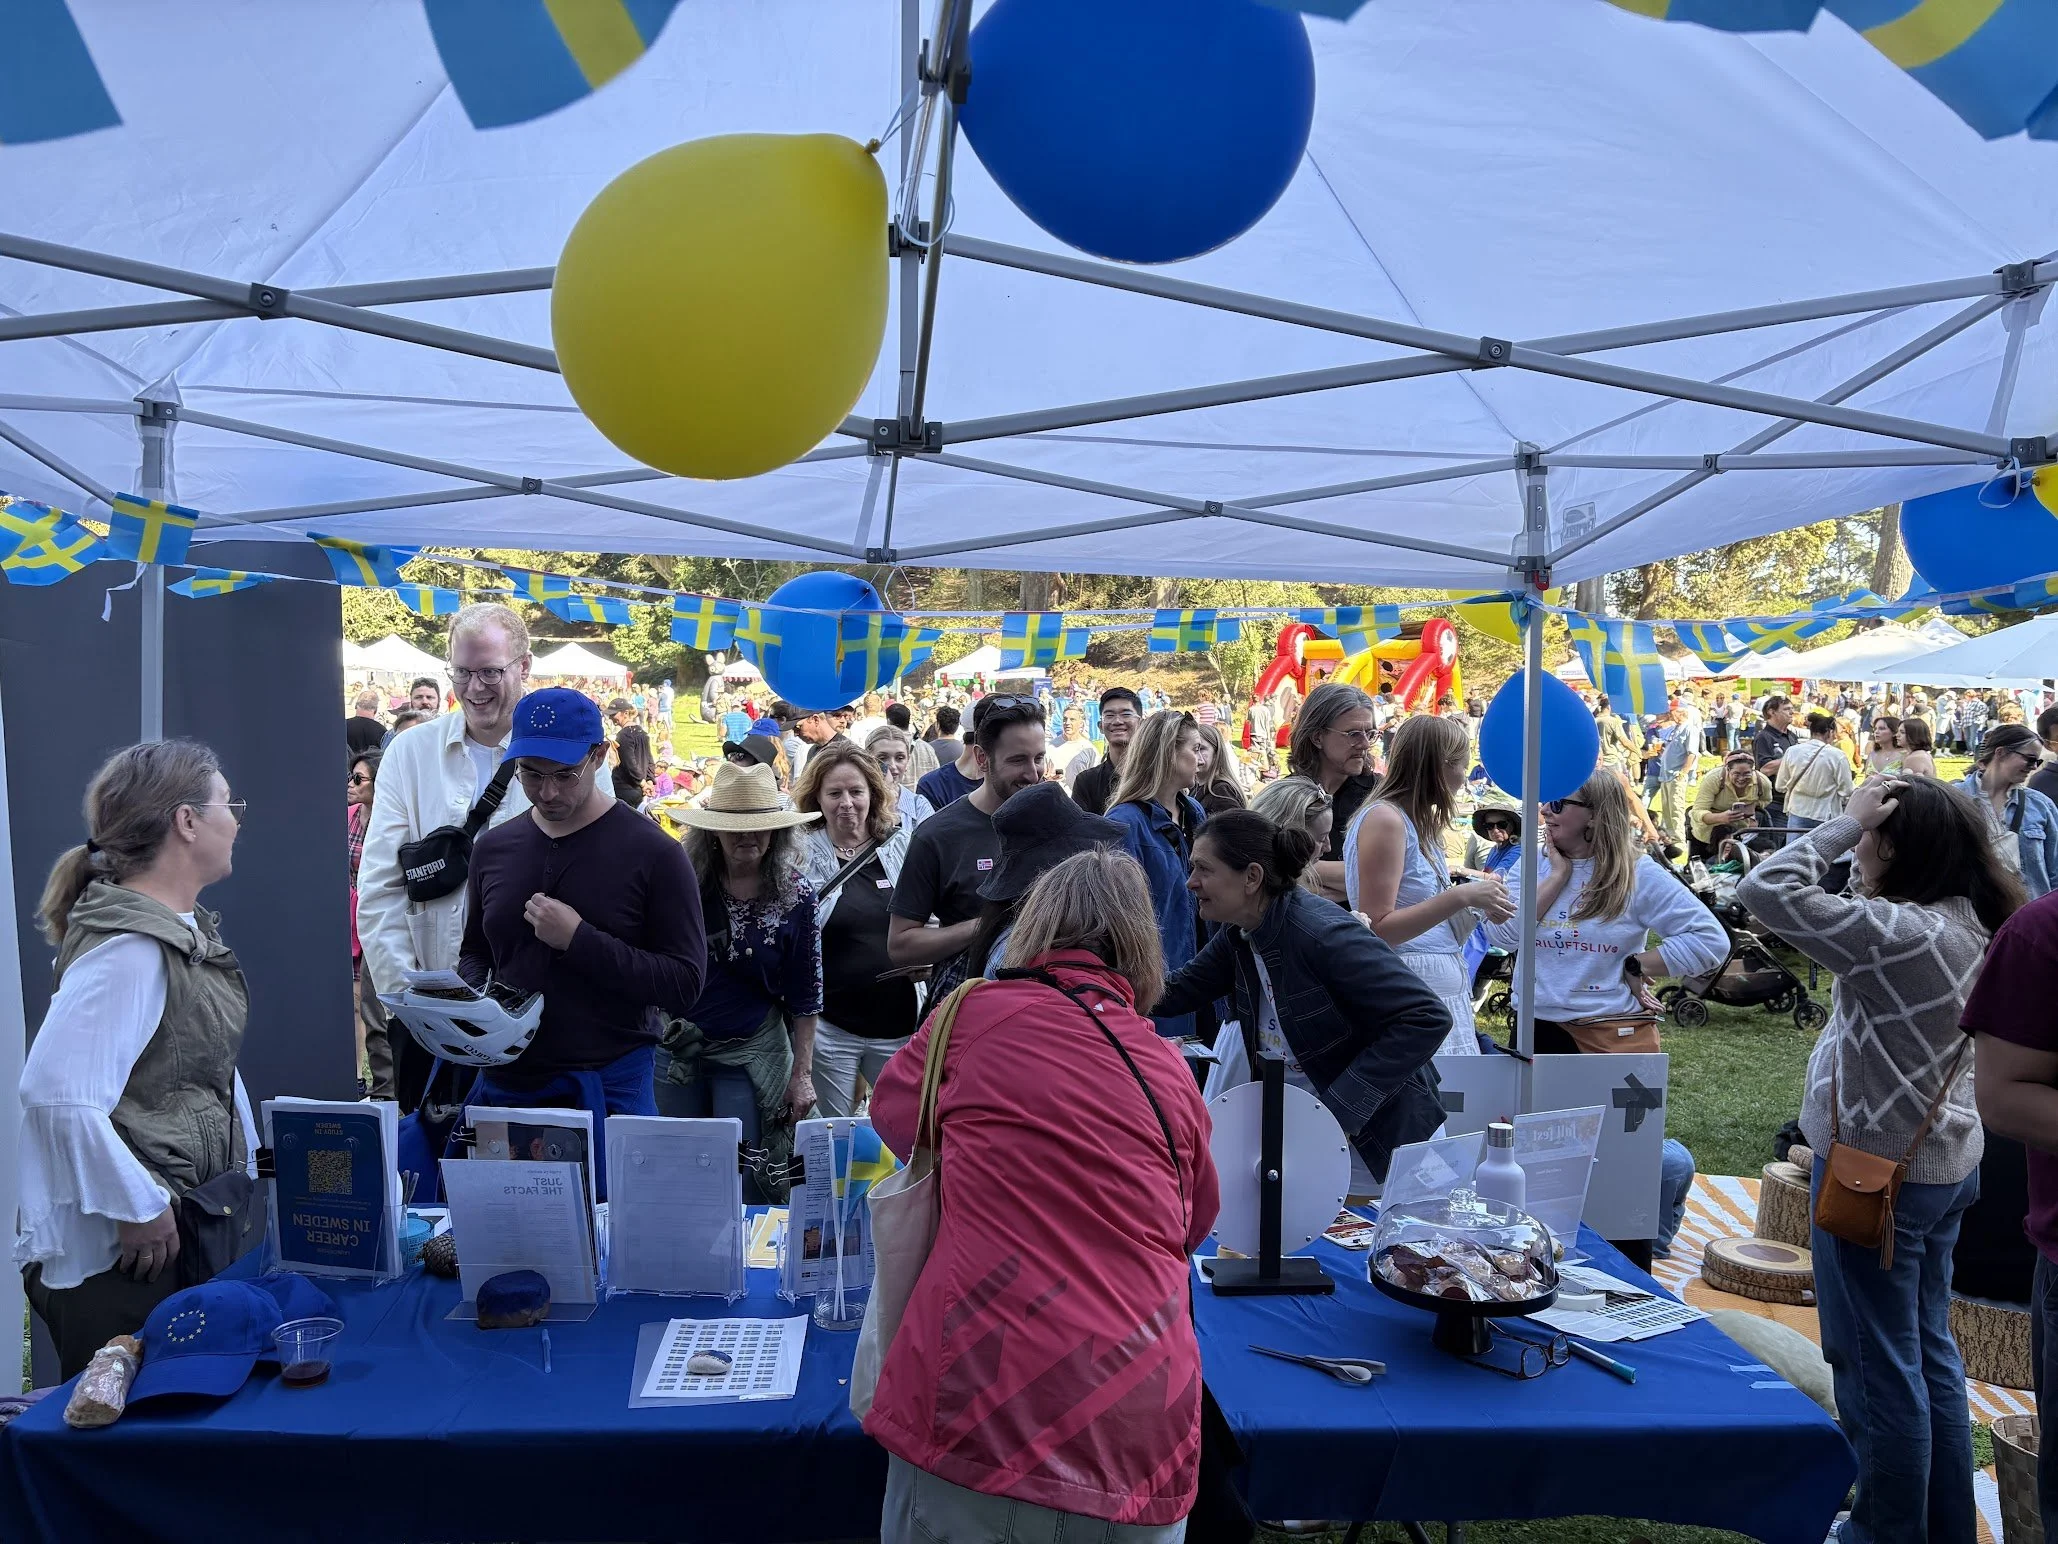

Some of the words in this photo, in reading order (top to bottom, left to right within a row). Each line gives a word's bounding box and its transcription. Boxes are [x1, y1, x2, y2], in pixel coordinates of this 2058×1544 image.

[405, 858, 446, 881] STANFORD
[1535, 939, 1612, 953] RILUFTSLIV
[292, 1213, 350, 1229] SWEDEN
[353, 1219, 371, 1233] IN
[306, 1230, 360, 1247] CAREER
